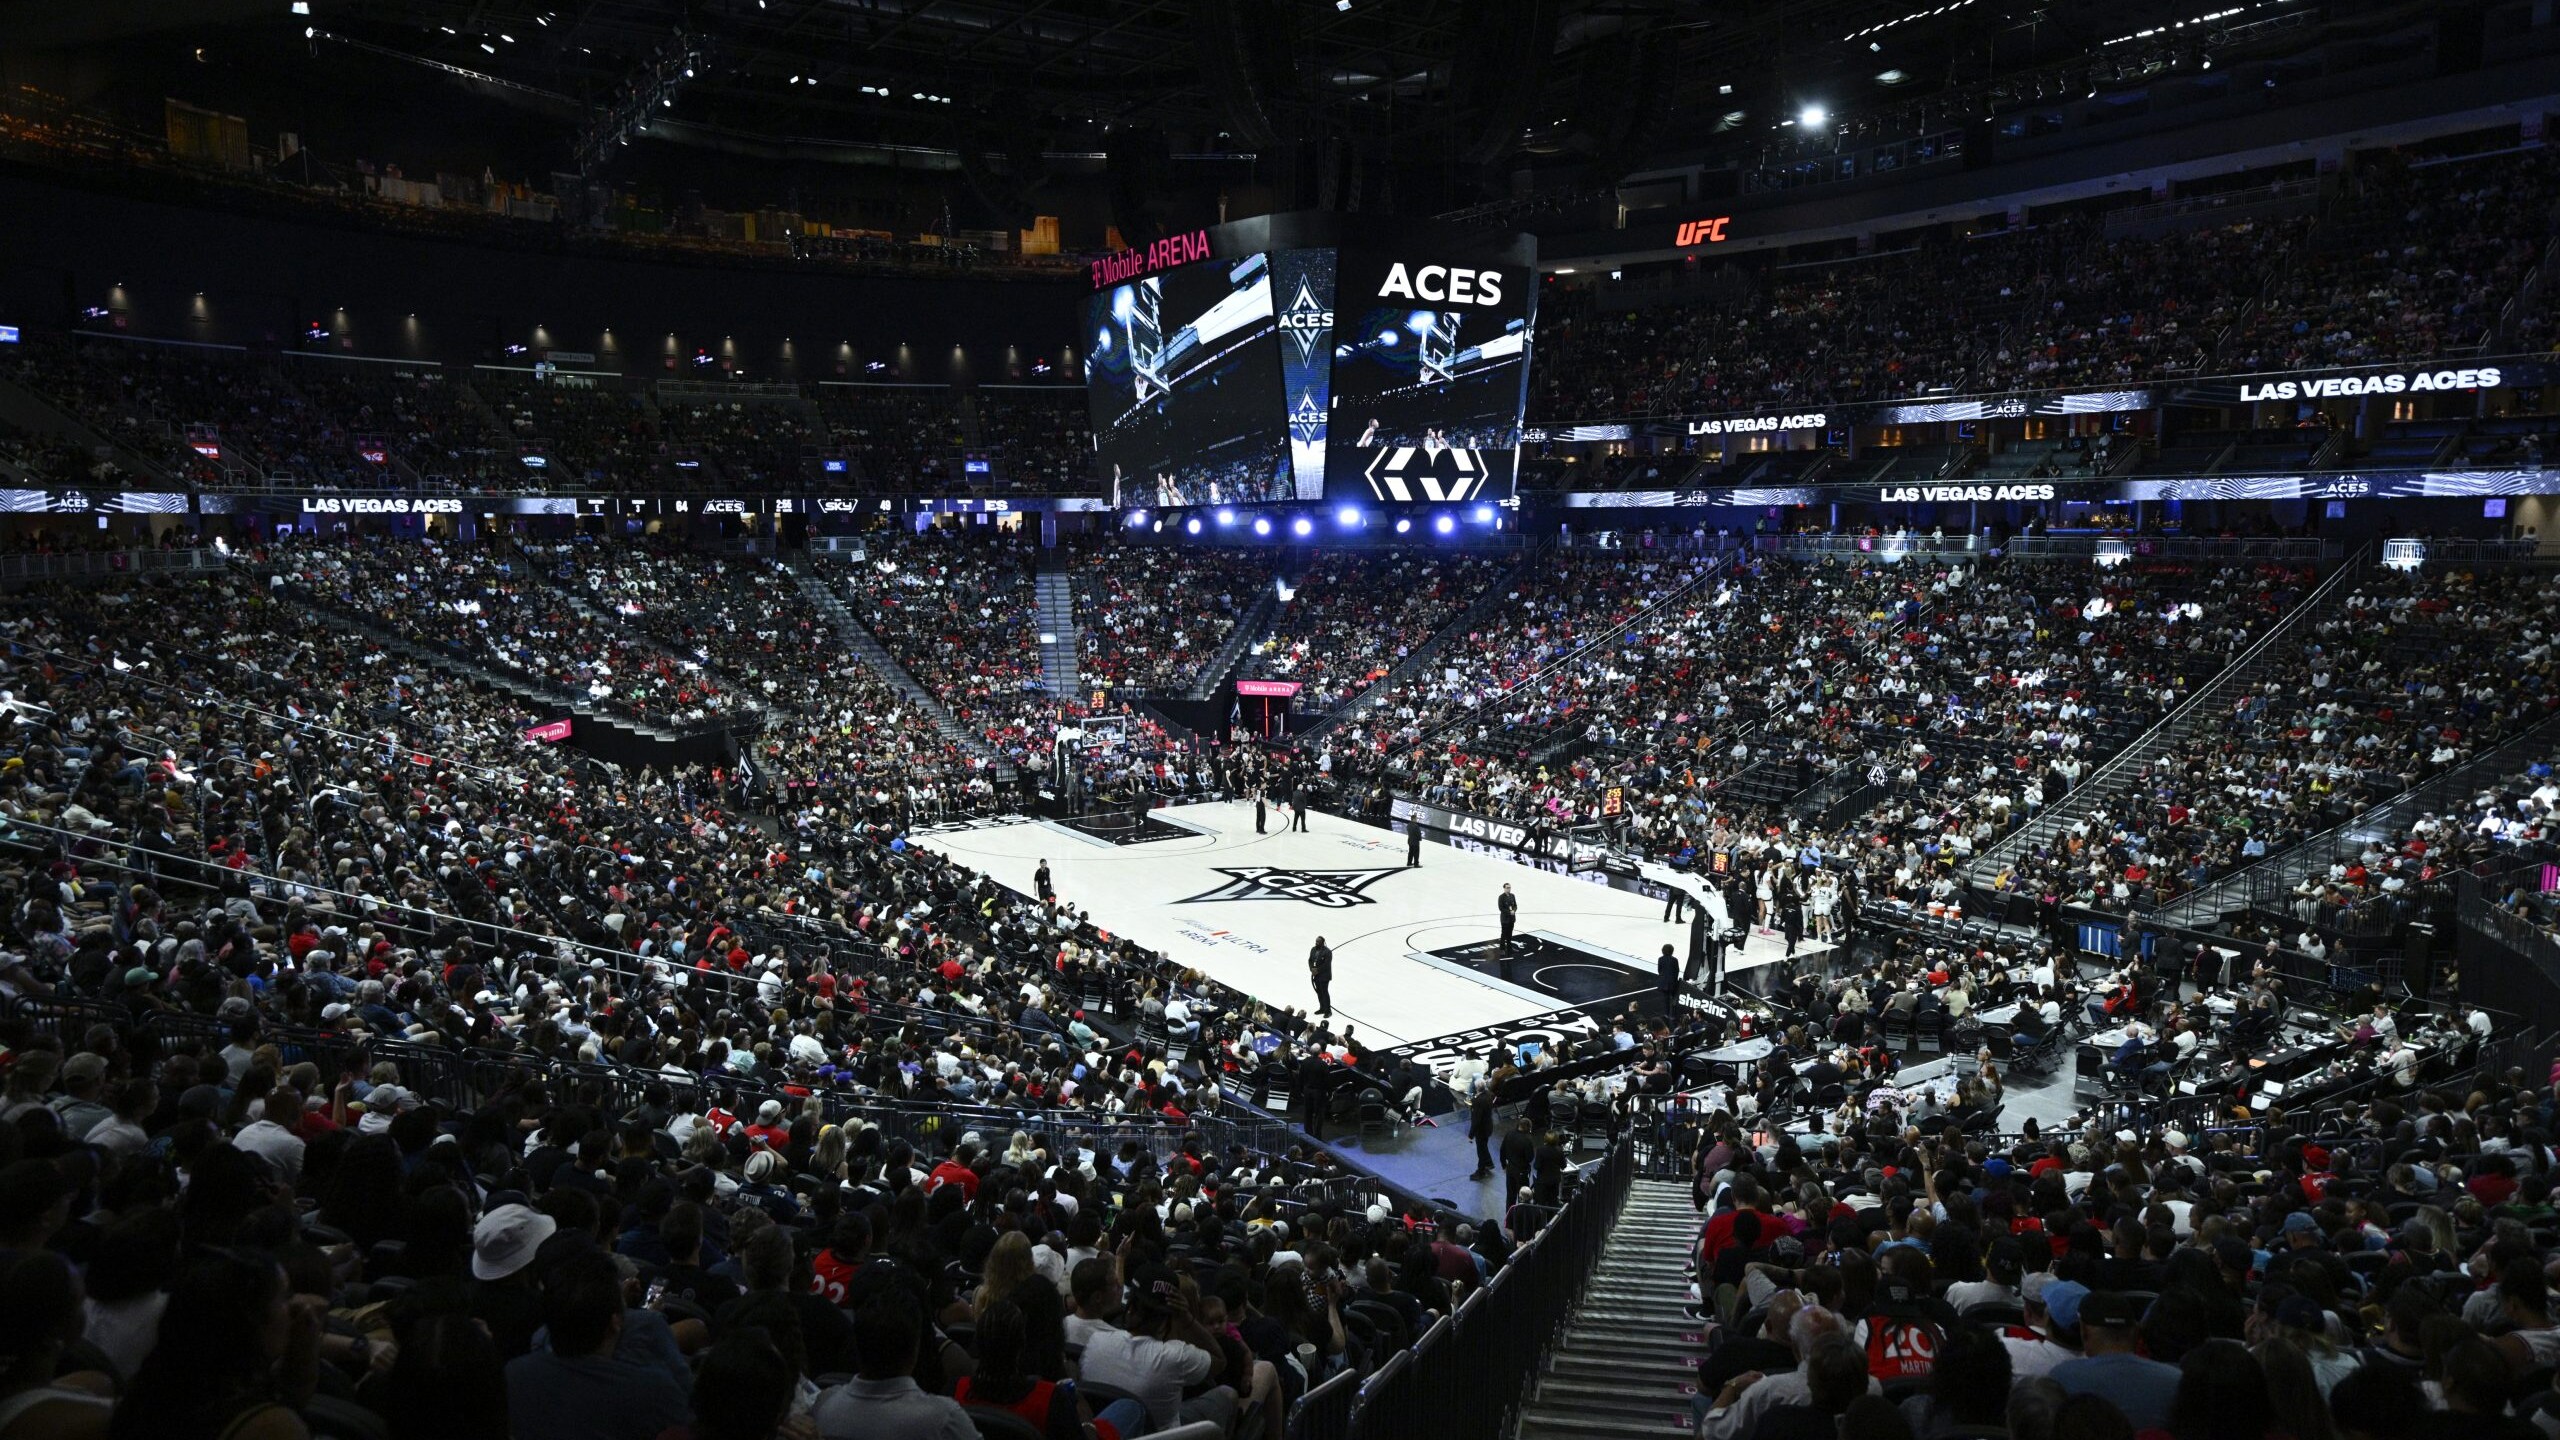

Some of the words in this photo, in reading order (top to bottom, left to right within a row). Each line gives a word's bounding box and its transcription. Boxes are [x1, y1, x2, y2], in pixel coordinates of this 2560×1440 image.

[1676, 217, 1729, 246] UFC
[1147, 229, 1210, 271] ARENA
[1378, 262, 1502, 306] ACES
[1279, 313, 1334, 328] ACES
[2241, 382, 2295, 402] LAS
[2301, 374, 2405, 398] VEGAS
[2409, 368, 2501, 391] ACES
[1996, 404, 2026, 414] ACES
[1289, 412, 1328, 424] ACES
[1689, 421, 1722, 435] LAS
[1724, 417, 1778, 433] VEGAS
[1779, 413, 1826, 431] ACES
[1524, 432, 1546, 441] ACES
[1881, 488, 1920, 502] LAS
[1923, 486, 1995, 502] VEGAS
[1997, 484, 2055, 501] ACES
[2327, 482, 2369, 494] ACES
[60, 498, 89, 508] ACES
[303, 499, 340, 512] LAS
[342, 499, 408, 513] VEGAS
[412, 499, 462, 513] ACES
[706, 503, 743, 512] ACES
[825, 502, 852, 511] SKY
[879, 500, 892, 511] 49
[1686, 496, 1708, 505] ACES
[1092, 698, 1104, 708] 23
[1607, 789, 1622, 798] 2:55
[1603, 798, 1621, 813] 23
[1450, 814, 1486, 837] LAS
[1714, 862, 1725, 872] 23
[1223, 869, 1365, 907] ACES
[1176, 929, 1219, 947] ARENA
[1221, 934, 1270, 955] ULTRA
[1518, 1009, 1585, 1027] LAS
[1390, 1026, 1511, 1056] VEGAS
[1883, 1324, 1935, 1361] 20
